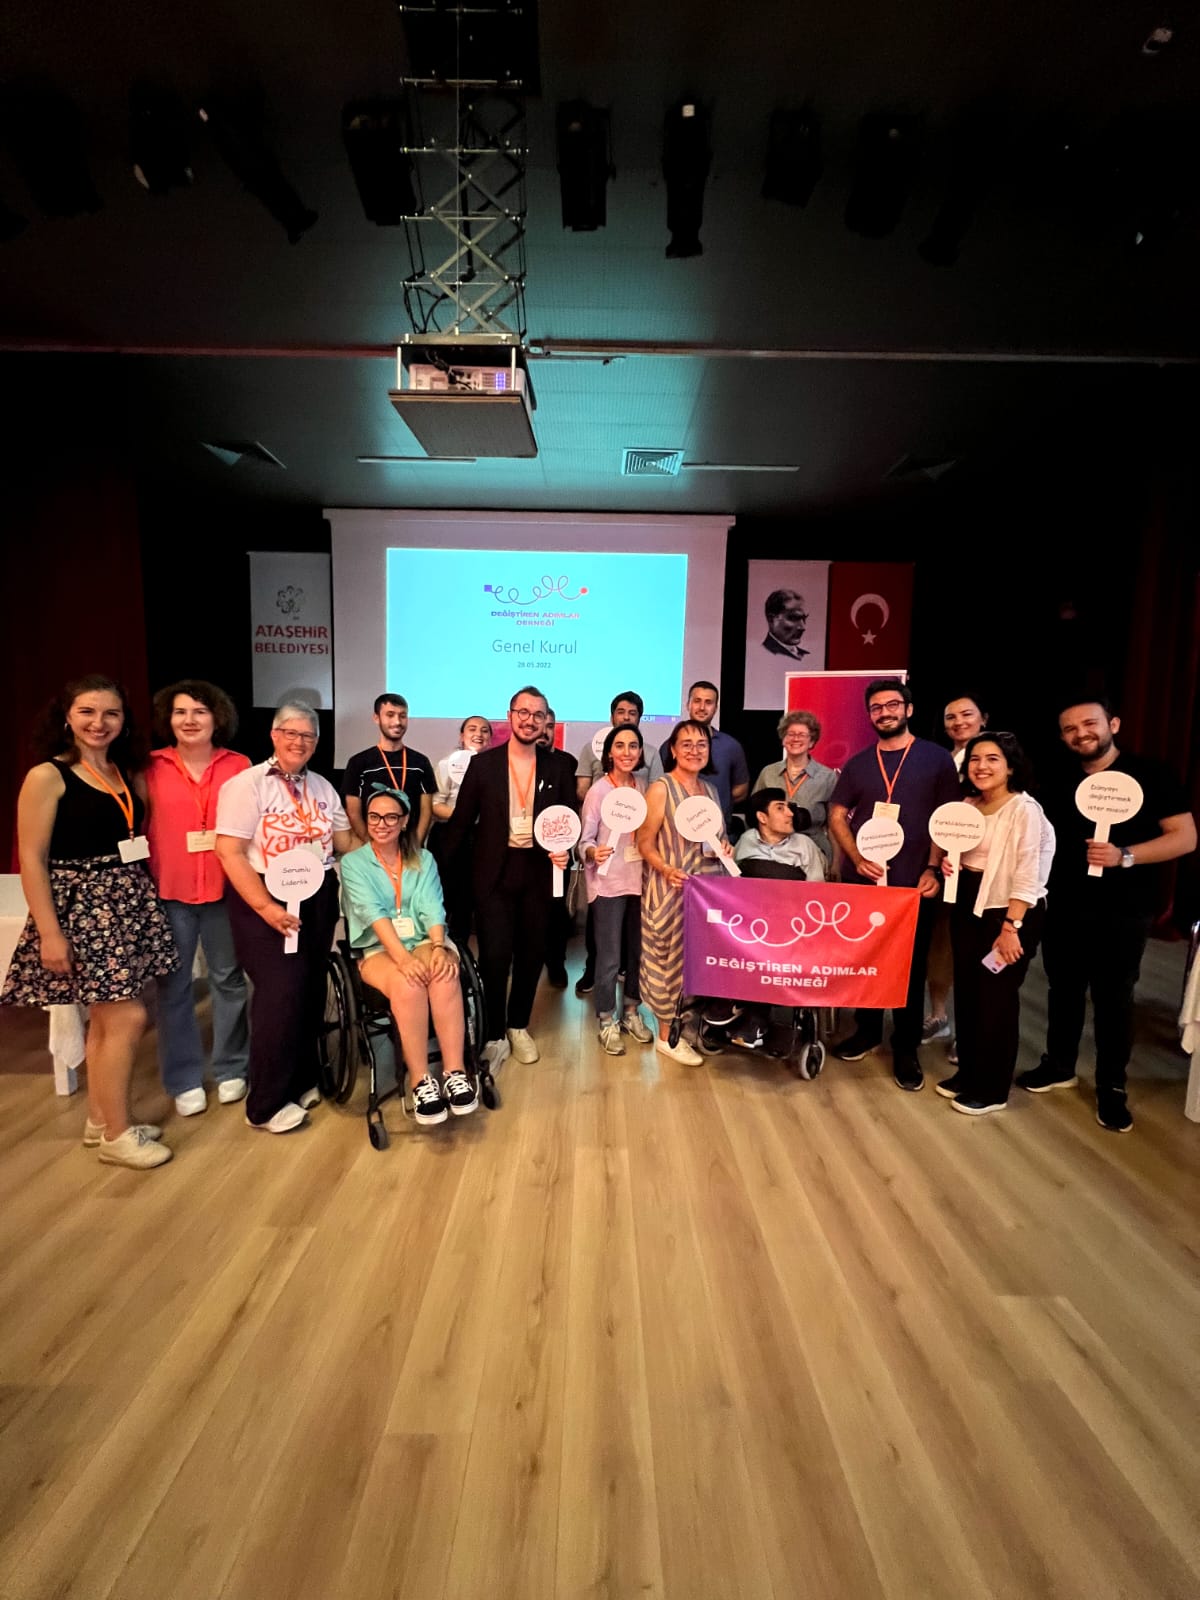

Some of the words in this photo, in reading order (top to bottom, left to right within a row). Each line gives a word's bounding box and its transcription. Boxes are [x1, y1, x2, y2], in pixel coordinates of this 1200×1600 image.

[255, 624, 328, 639] ATAŞEHİR
[491, 639, 535, 653] Genel
[540, 639, 577, 654] Kurul
[706, 956, 803, 974] DEĞİŞTİREN
[810, 965, 878, 977] ADIMLAR
[760, 975, 829, 988] DERNEĞİ
